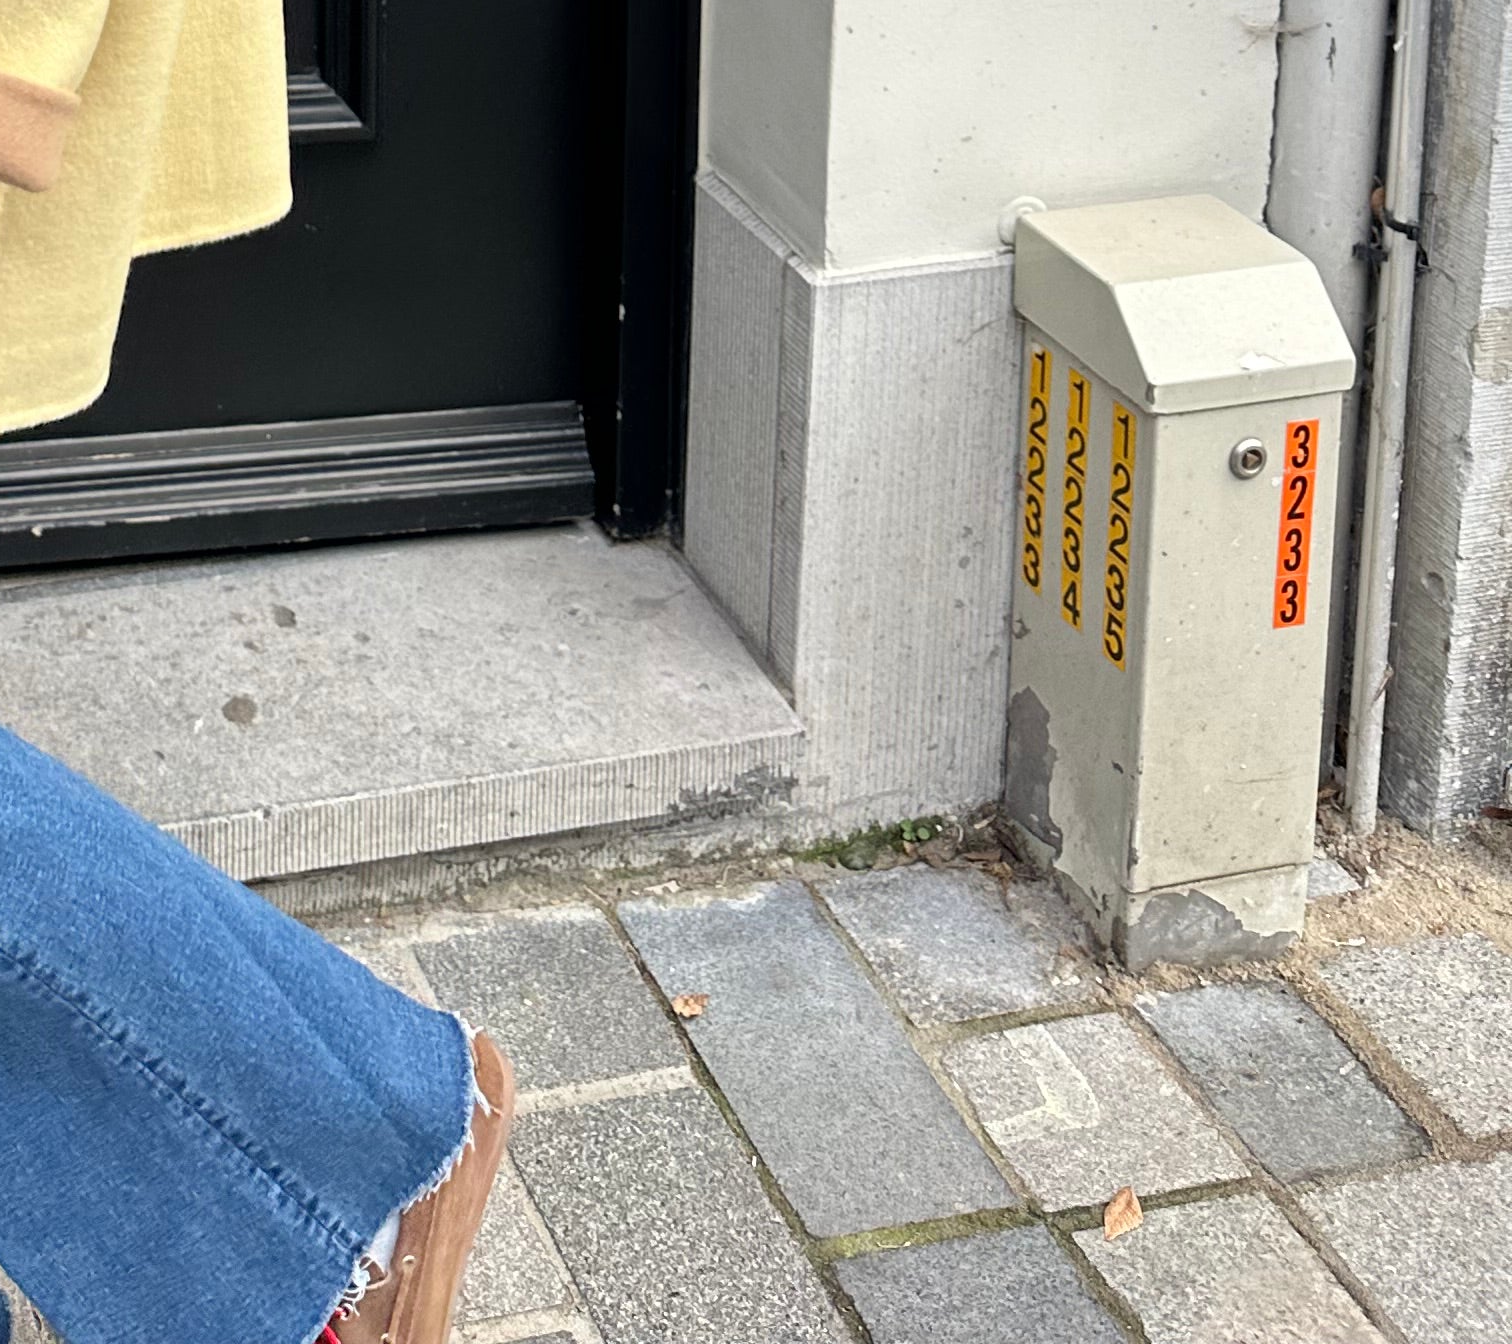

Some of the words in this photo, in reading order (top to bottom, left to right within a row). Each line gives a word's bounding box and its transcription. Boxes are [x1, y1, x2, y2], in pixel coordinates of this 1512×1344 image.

[1023, 350, 1047, 588] 12233
[1062, 379, 1086, 626] 12234
[1104, 414, 1131, 662] 12235
[1279, 424, 1310, 623] 3233
